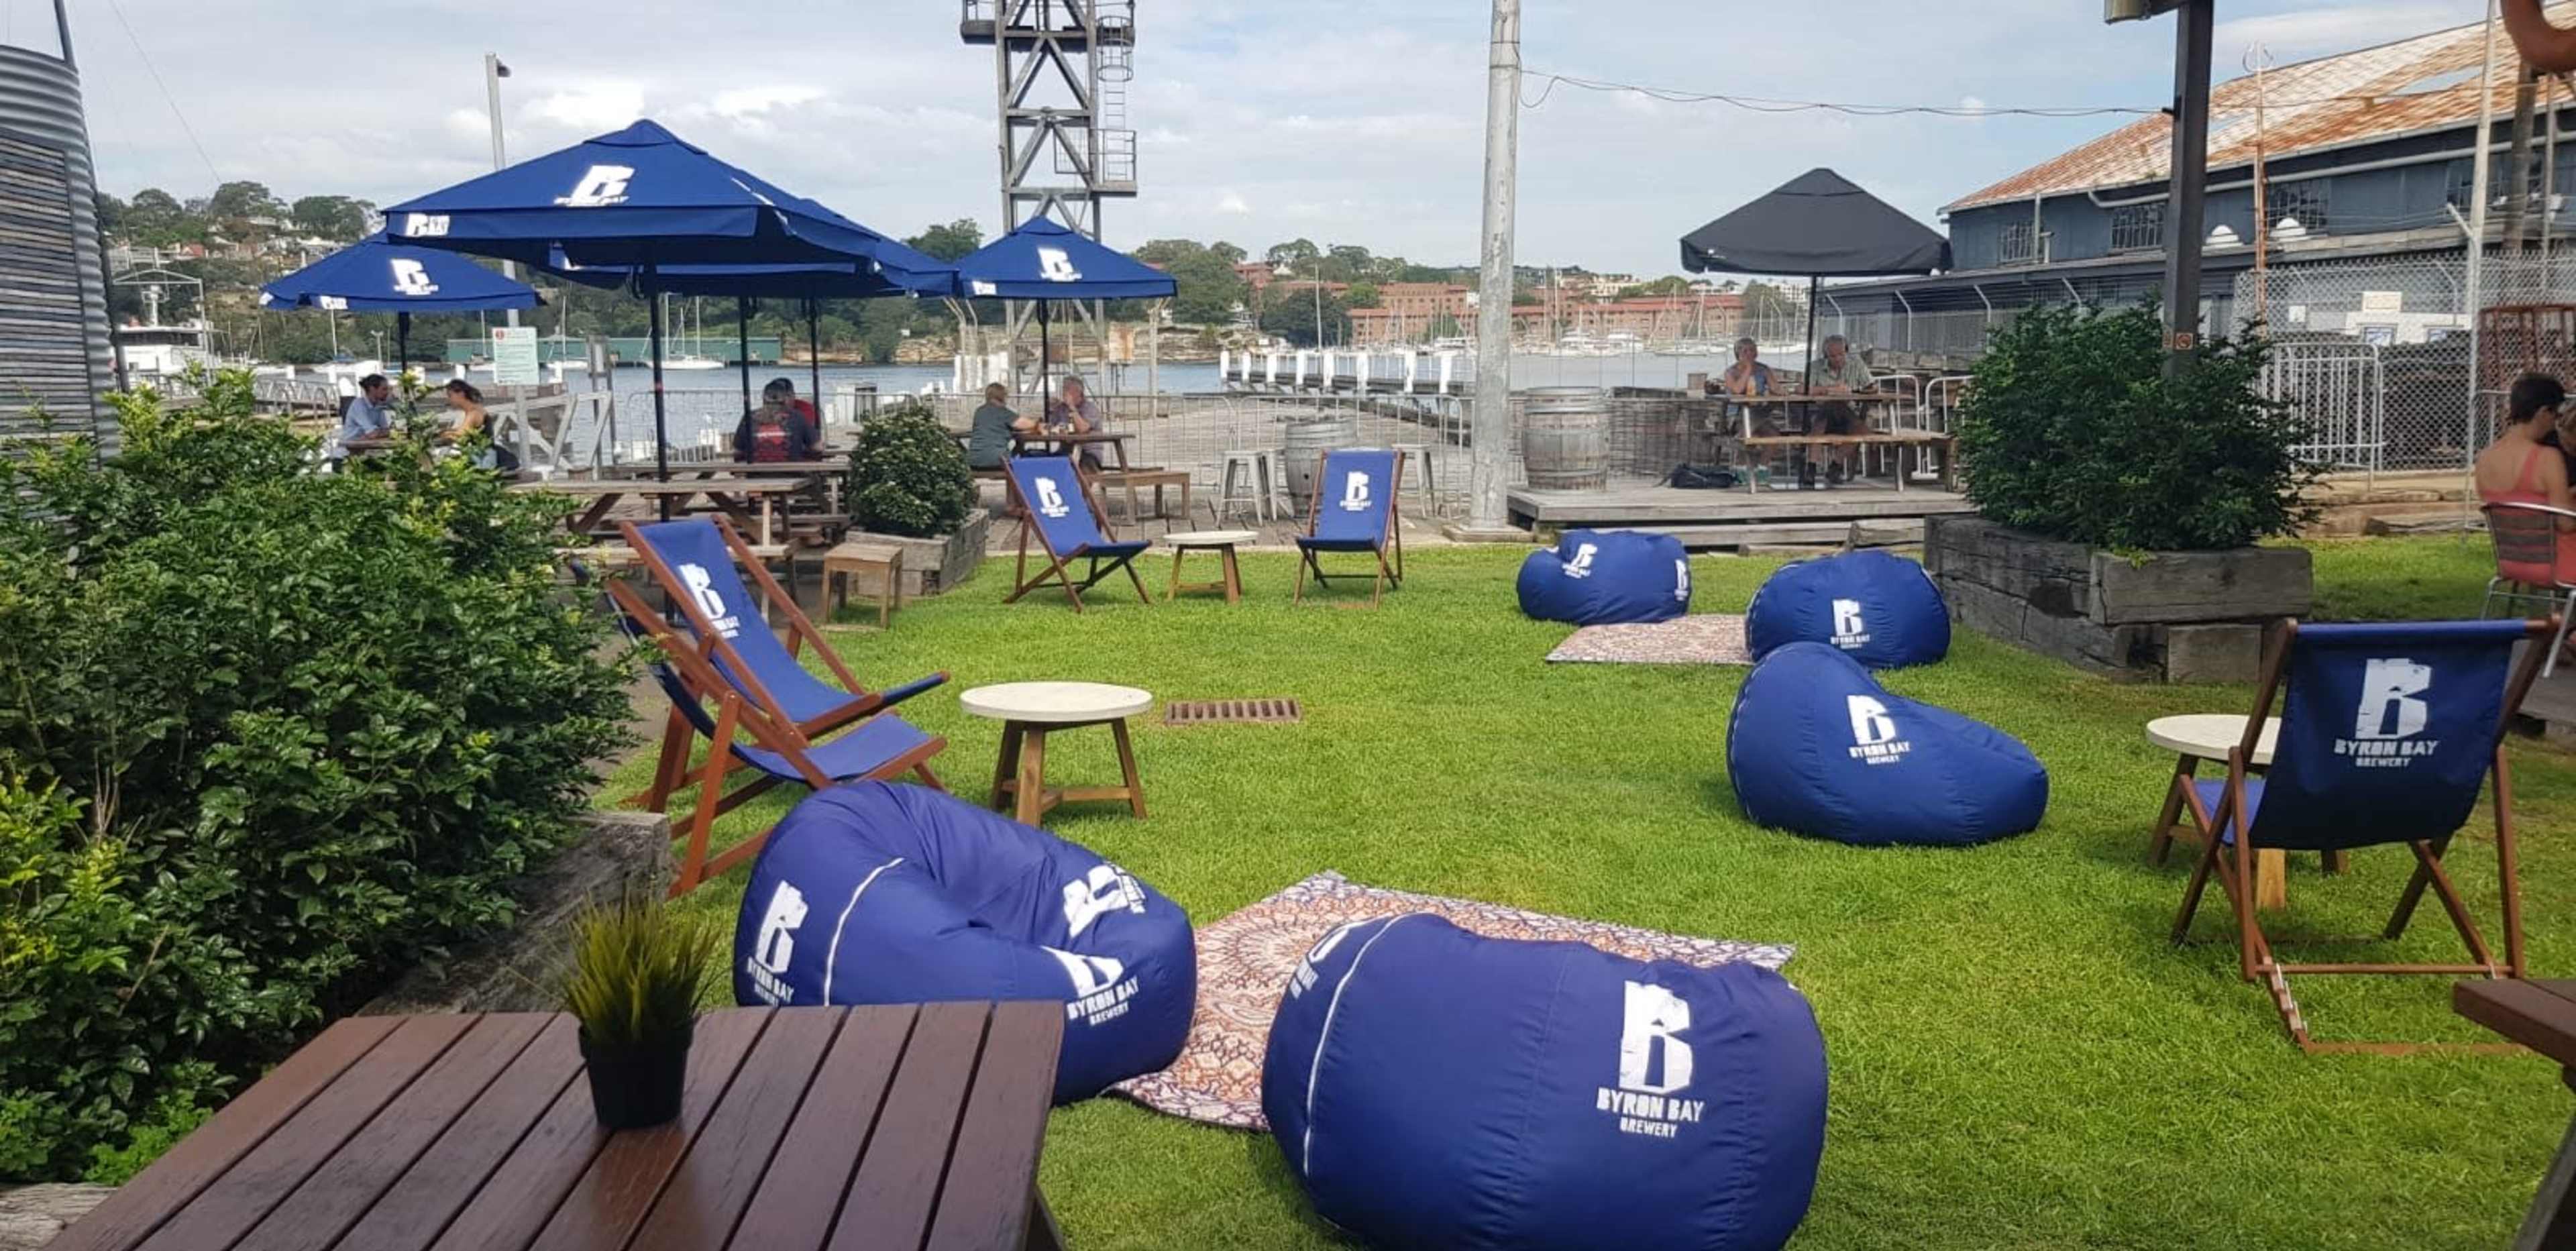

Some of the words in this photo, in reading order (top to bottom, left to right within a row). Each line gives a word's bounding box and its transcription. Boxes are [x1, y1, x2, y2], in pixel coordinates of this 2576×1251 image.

[1035, 477, 1063, 508] B
[1346, 472, 1368, 502] B
[677, 563, 726, 620] B
[1833, 599, 1862, 636] B
[2355, 658, 2432, 739] B
[1847, 695, 1896, 745] B
[2334, 739, 2398, 756] BYRON
[2400, 740, 2440, 755] BAY
[755, 879, 809, 974] B
[1067, 989, 1116, 1020] BYRON
[1114, 975, 1140, 1002] BAY
[1619, 980, 1693, 1094] B
[1596, 1087, 1664, 1119] BYRON
[1667, 1099, 1705, 1122] BAY
[1619, 1116, 1678, 1138] BREWERY
